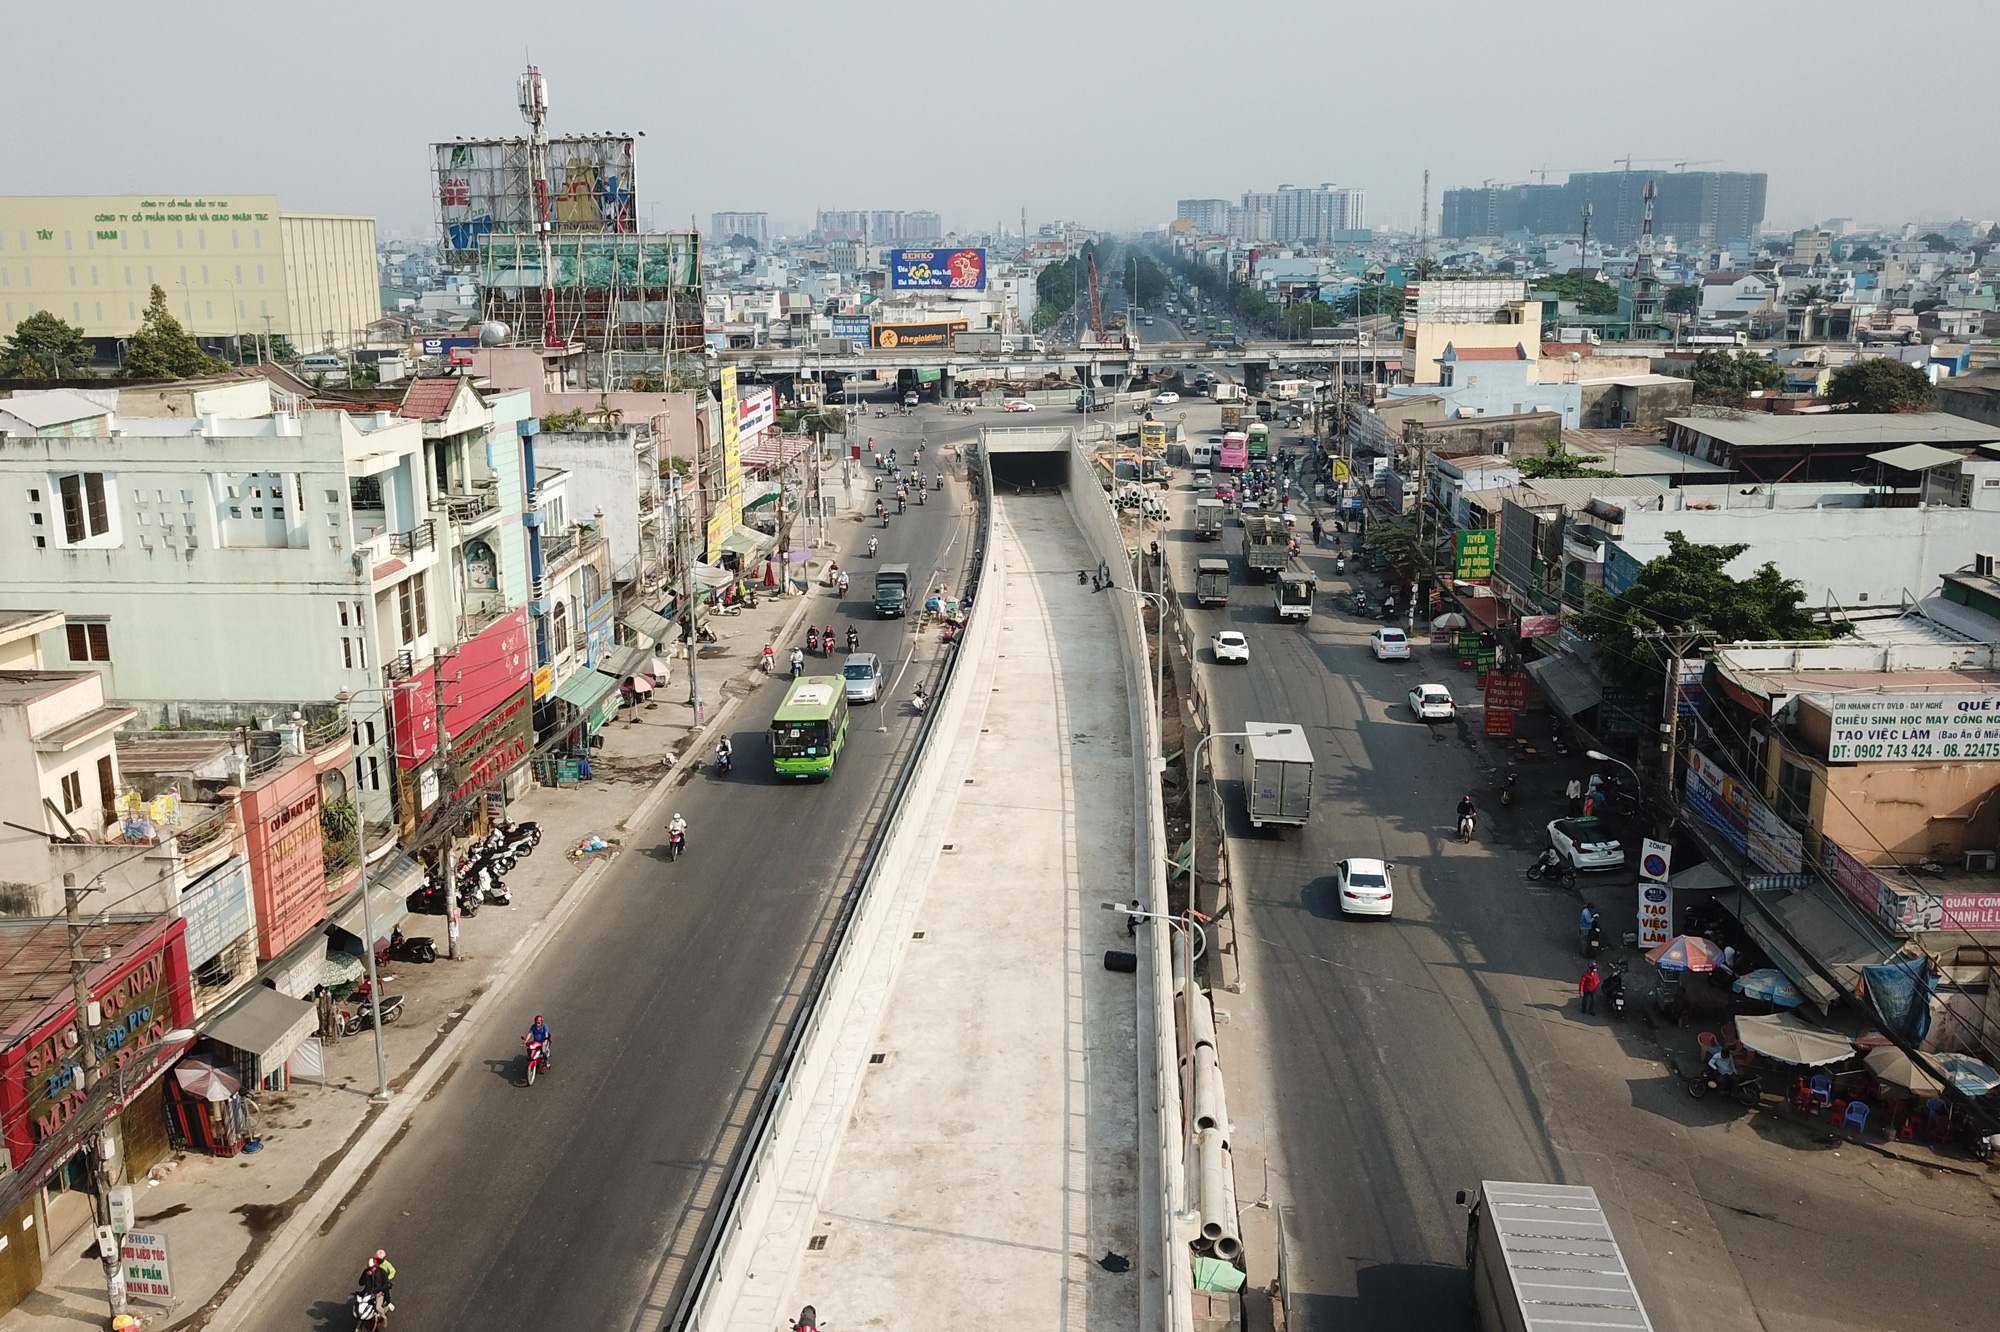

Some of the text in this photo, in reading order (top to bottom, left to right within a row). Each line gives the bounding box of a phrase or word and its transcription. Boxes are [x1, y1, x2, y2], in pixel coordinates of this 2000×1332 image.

[94, 213, 116, 222] CÔNG
[132, 212, 142, 222] CỔ
[145, 212, 165, 221] PHẦN
[199, 213, 209, 221] VÀ
[36, 228, 118, 240] TÂY NAM
[1463, 546, 1478, 555] NAM
[1848, 701, 1870, 710] NHÁNH
[1958, 697, 1994, 712] QUẾ
[1835, 714, 1868, 725] CHIÊU
[1871, 716, 1896, 725] SINH
[1900, 716, 1922, 726] HỌC
[1926, 716, 1949, 724] MAY
[1953, 713, 1982, 724] CÔNG
[1837, 731, 1863, 743] TẠO
[1868, 728, 1898, 742] VIỆC
[1902, 728, 1930, 739] LÀM
[1938, 731, 1957, 740] (Bao
[1832, 745, 1850, 758] ĐT:
[1854, 744, 1882, 758] 0902
[1887, 744, 1908, 758] 743
[1911, 744, 1932, 758] 424
[1944, 744, 1960, 757] 08.
[1964, 743, 2000, 757] 22475
[1946, 897, 2000, 908] QUÁN CƠM
[1644, 905, 1666, 916] TẠO
[1944, 911, 1980, 923] THANH
[1981, 909, 1993, 922] LÊ
[1642, 917, 1668, 930] VIỆC
[1644, 931, 1666, 942] LÀM
[130, 954, 164, 997] NAM
[128, 1234, 156, 1245] SHOP
[152, 1247, 165, 1261] TÓC
[126, 1282, 149, 1294] MINH
